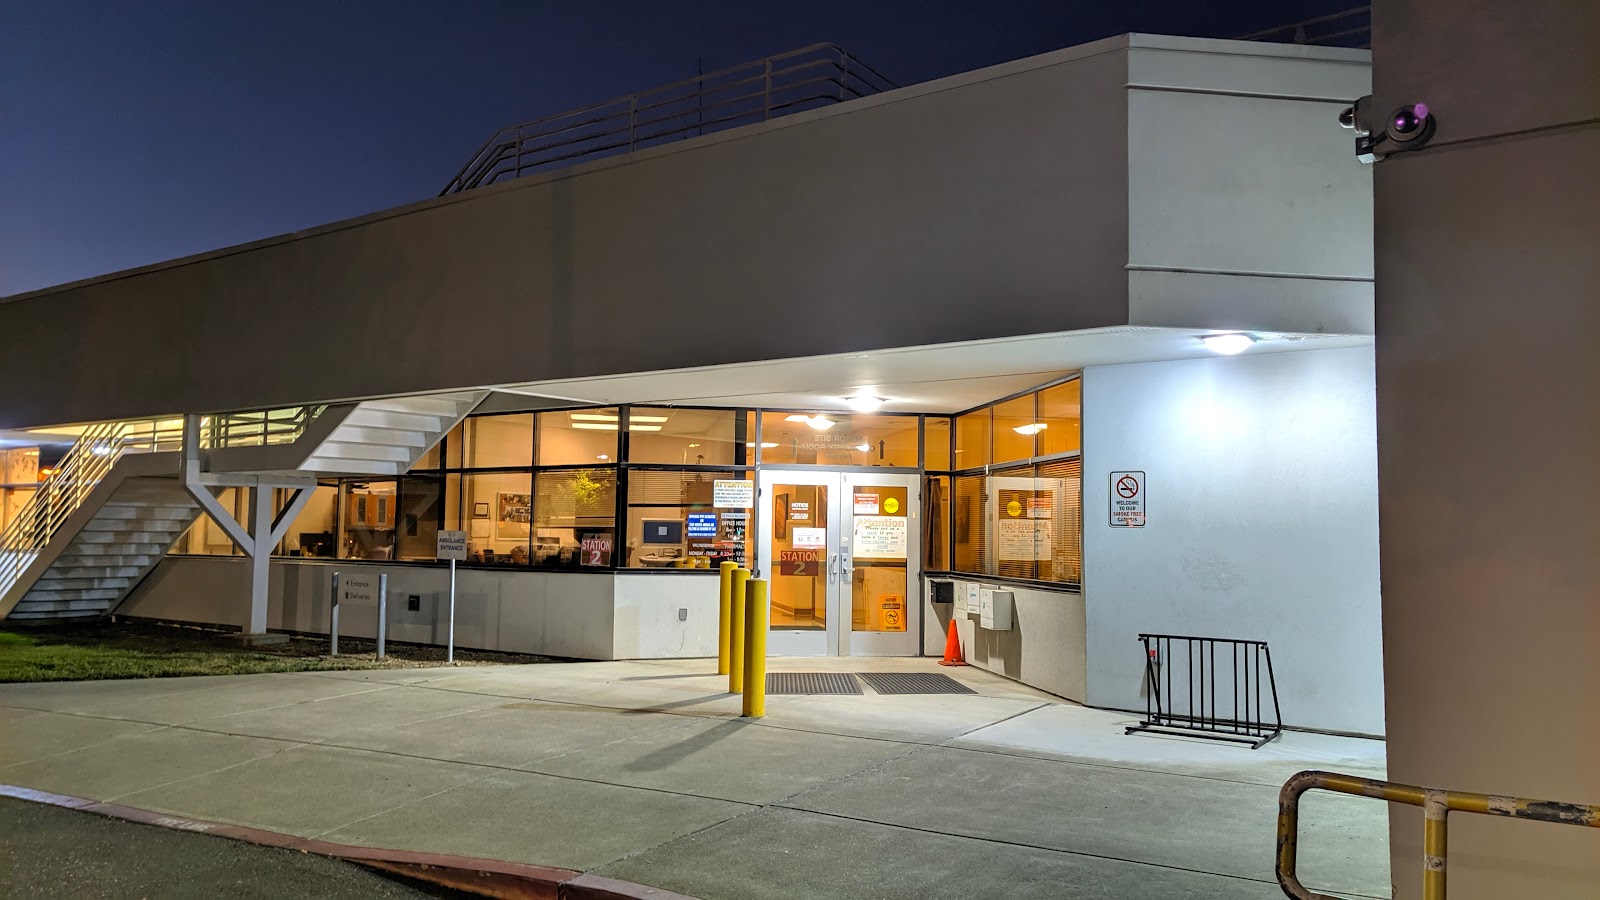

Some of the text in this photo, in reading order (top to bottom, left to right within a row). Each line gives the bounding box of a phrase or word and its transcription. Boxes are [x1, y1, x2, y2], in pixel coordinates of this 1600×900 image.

[856, 518, 904, 527] Attention
[582, 540, 612, 551] STATION
[591, 550, 601, 565] 2
[781, 551, 819, 562] STATION
[793, 562, 807, 575] 2
[350, 592, 370, 600] Deliveries
